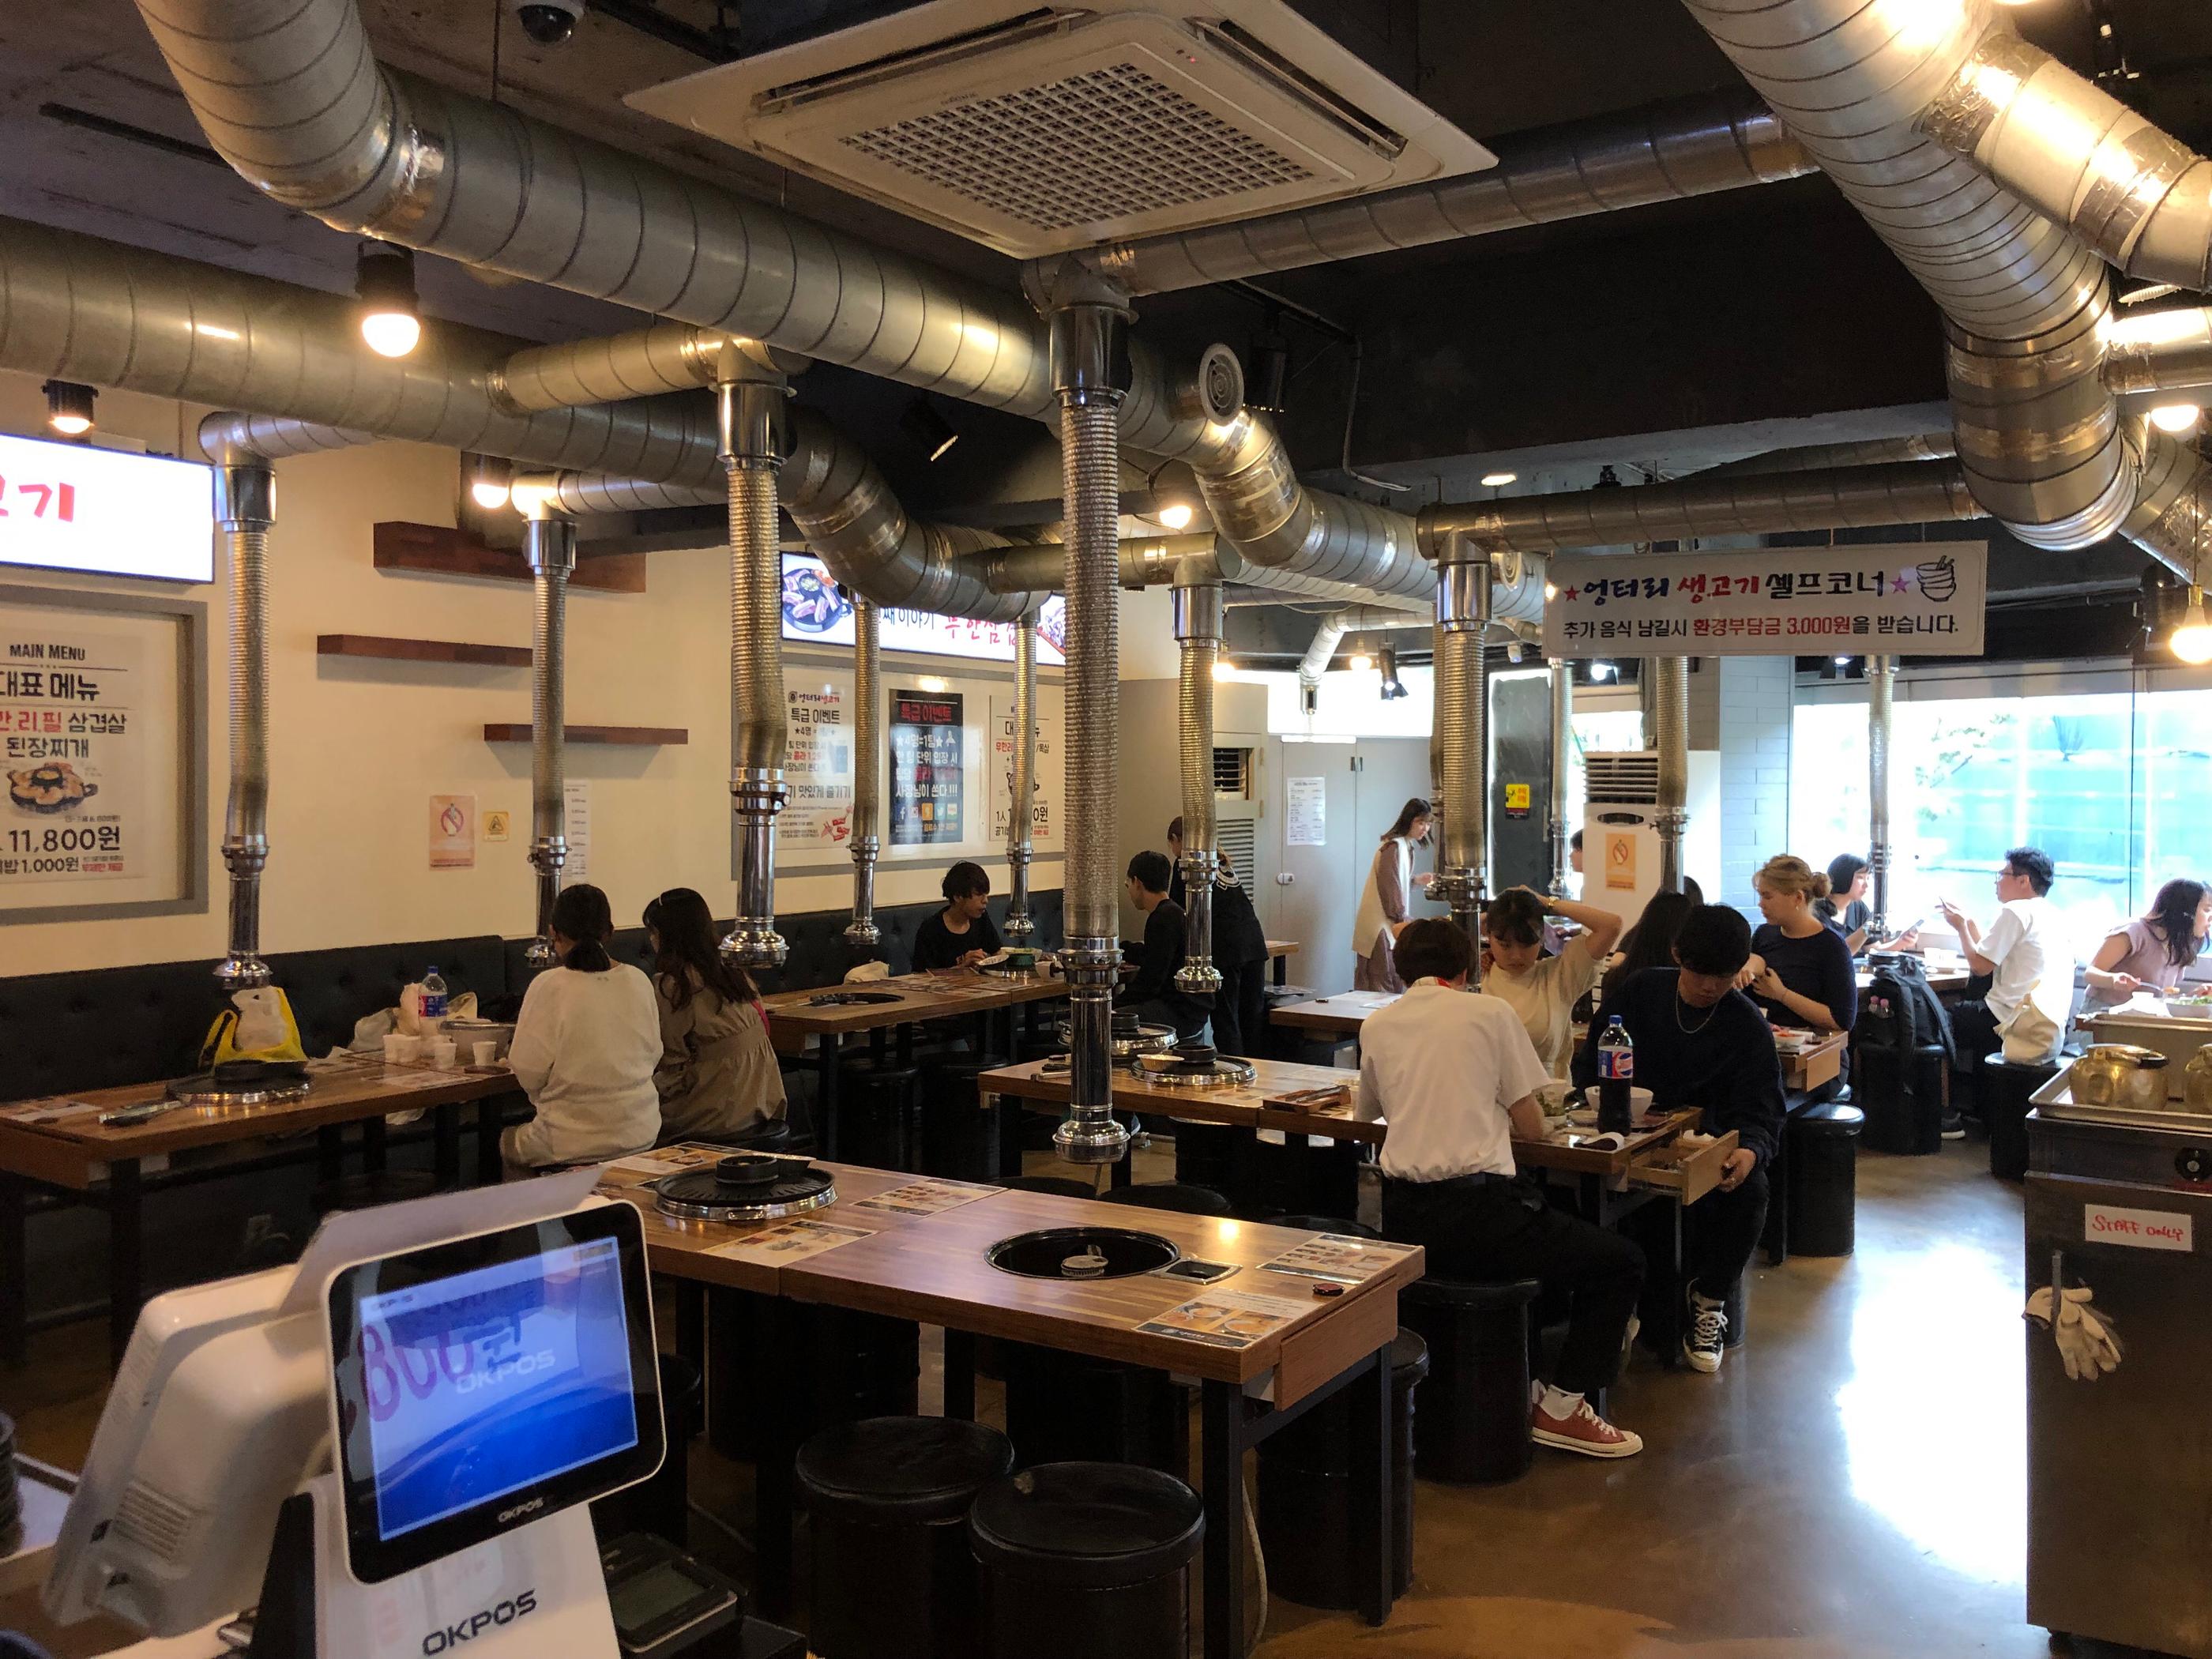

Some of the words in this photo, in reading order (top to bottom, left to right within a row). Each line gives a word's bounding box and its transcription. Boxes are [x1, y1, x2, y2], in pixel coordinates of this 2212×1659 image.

[0, 475, 74, 522] 기
[1584, 579, 1669, 606] 엉터리
[1677, 574, 1759, 604] 생고기
[1766, 571, 1884, 599] 셀프코너
[1563, 622, 1595, 639] 추가
[1601, 619, 1631, 638] 음식
[1638, 619, 1687, 638] 남길시
[1693, 617, 1781, 637] 환경부담금
[1877, 615, 1959, 634] 받습니다.
[9, 644, 44, 658] MAIN
[49, 645, 85, 660] MENU
[50, 673, 100, 702] 메뉴
[68, 713, 126, 734] 삼겹살
[791, 707, 810, 723] 특급
[813, 709, 841, 724] 이벤트
[901, 702, 920, 721] 특급
[923, 703, 952, 722] 이벤트
[6, 737, 88, 758] 된장찌개
[916, 750, 931, 764] 단위
[9, 826, 121, 853] 11,800원
[0, 860, 19, 875] 밥
[456, 1349, 556, 1394] OKPOS
[498, 1497, 544, 1523] OKPOS
[422, 1588, 538, 1657] OKPOS
